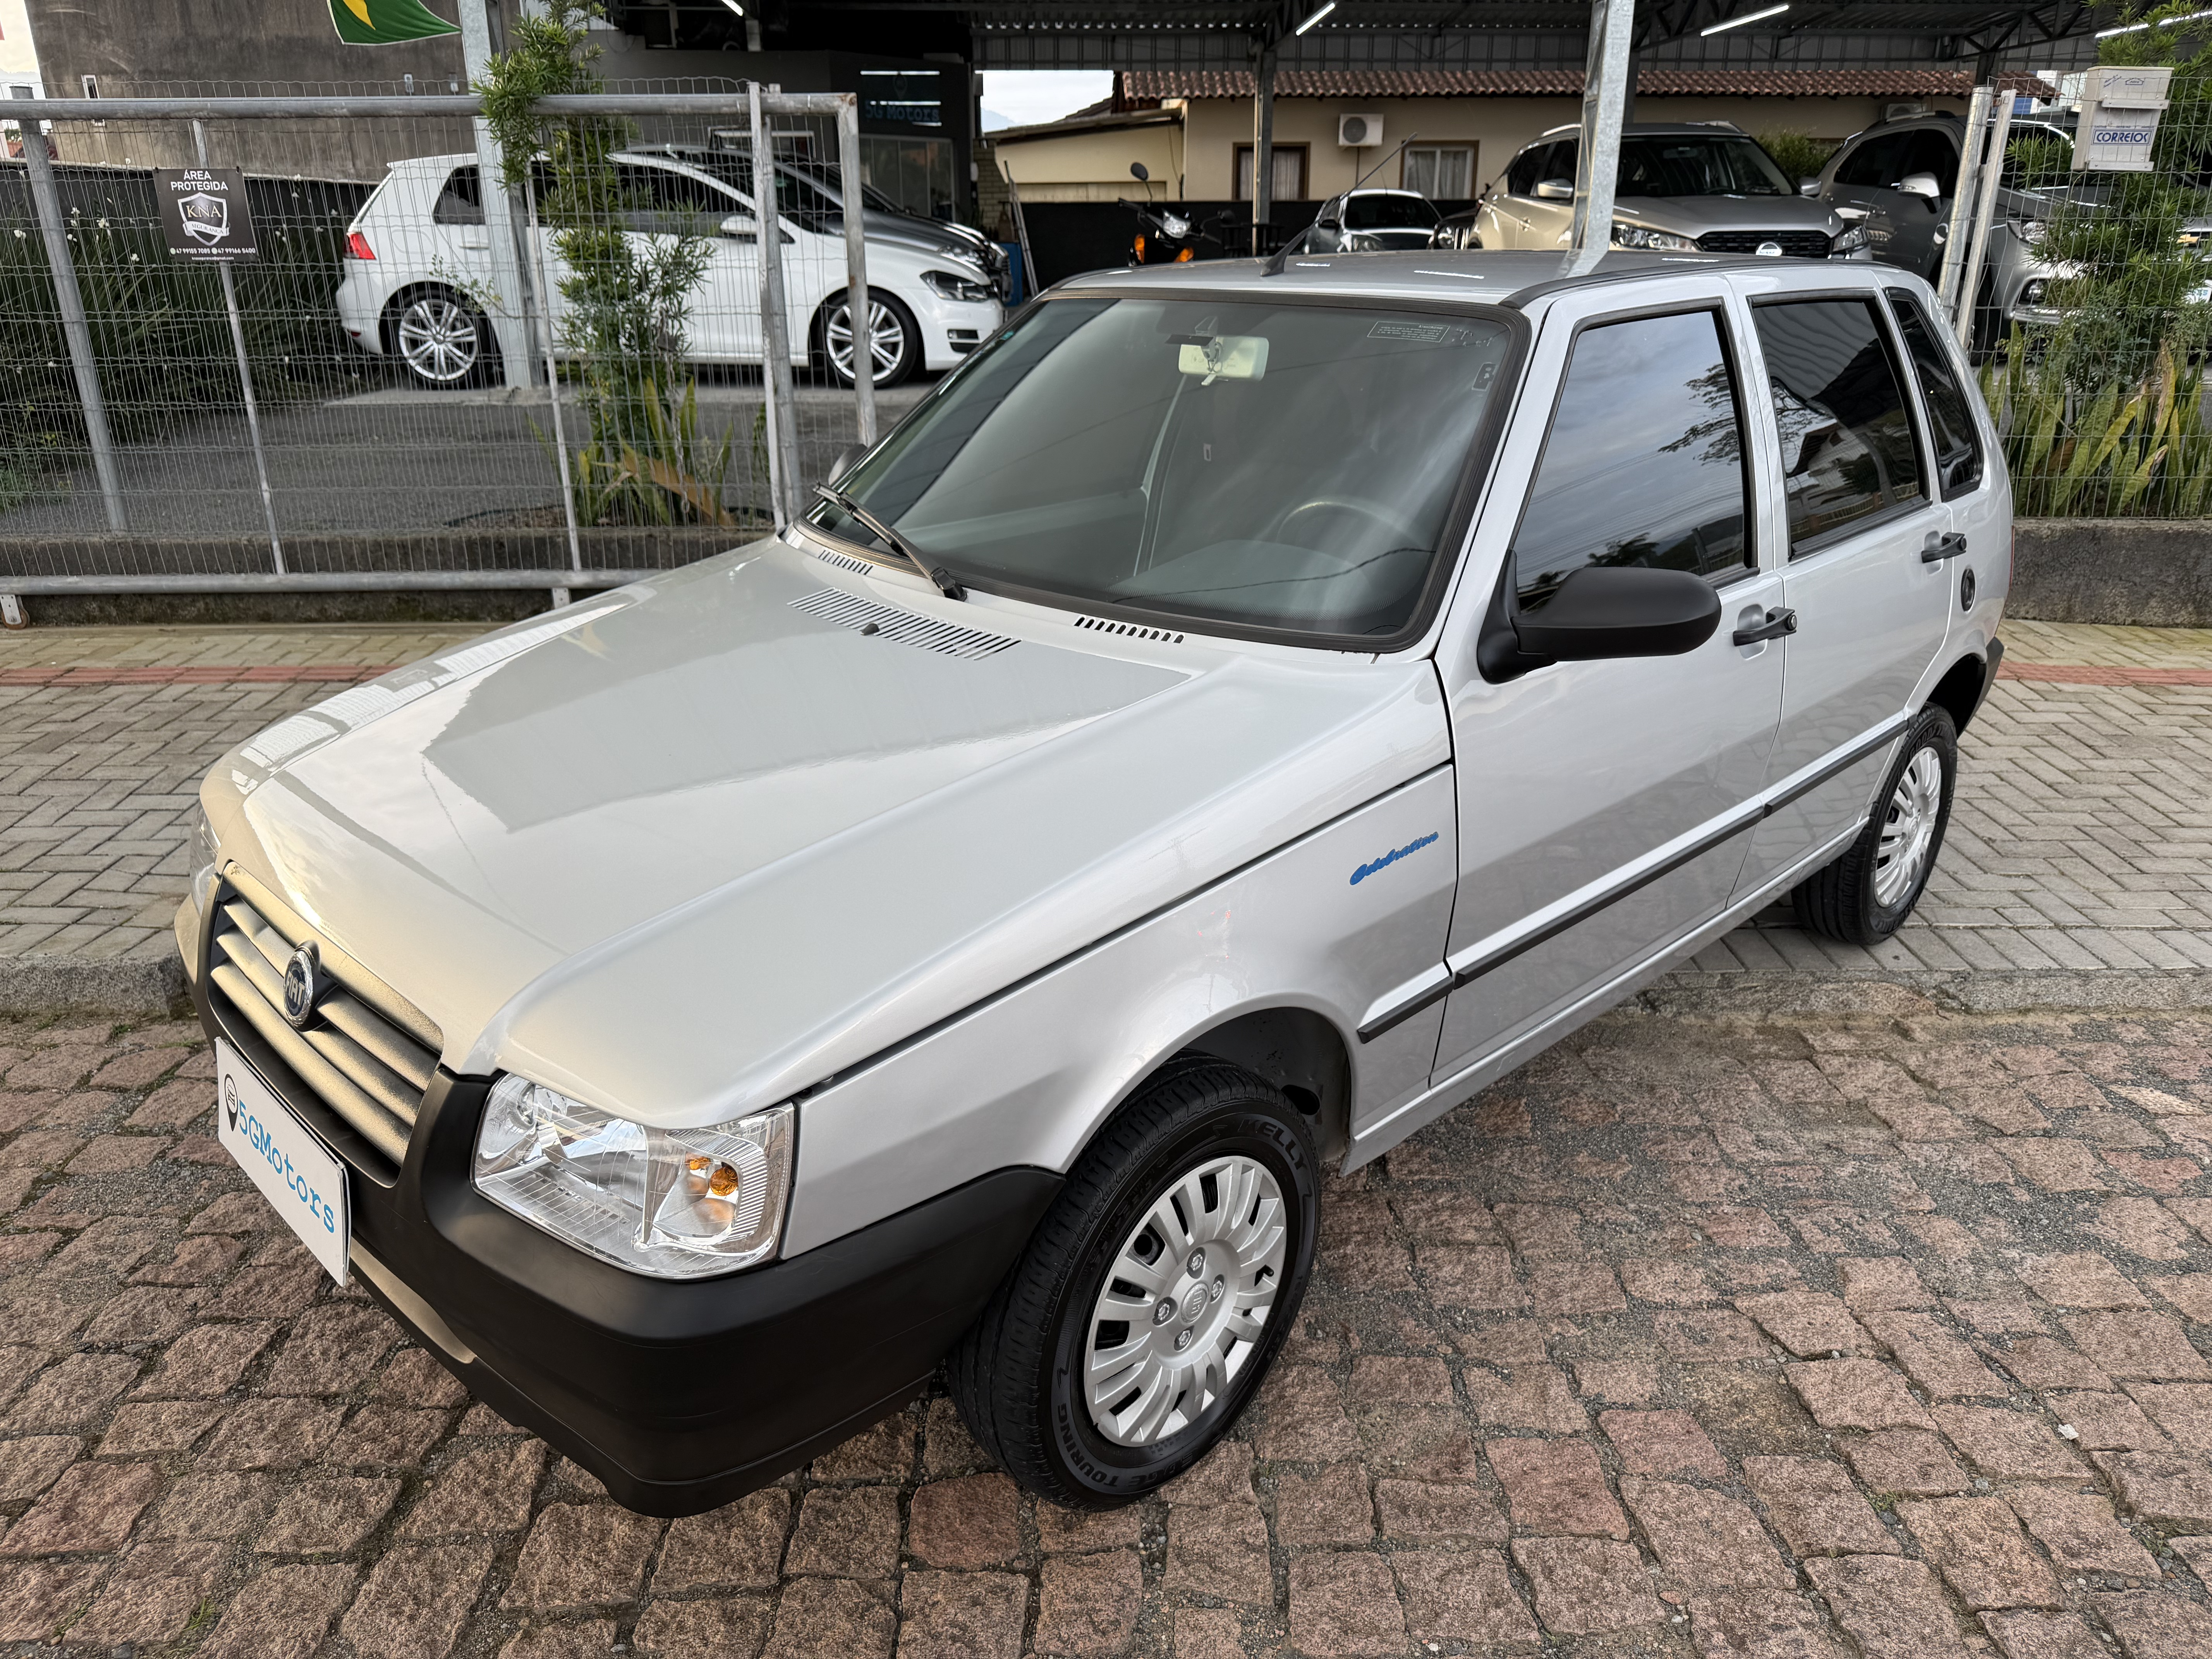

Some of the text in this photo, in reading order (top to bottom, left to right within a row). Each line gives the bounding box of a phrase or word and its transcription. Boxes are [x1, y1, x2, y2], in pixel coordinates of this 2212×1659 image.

[171, 181, 228, 191] PROTEGIDA
[184, 169, 211, 180] ÁREA
[186, 205, 222, 218] KNA
[286, 970, 305, 1006] FIAT
[1237, 1118, 1307, 1170] KELLY
[239, 1099, 335, 1233] 5GMotors
[1058, 1403, 1119, 1487] TOURING
